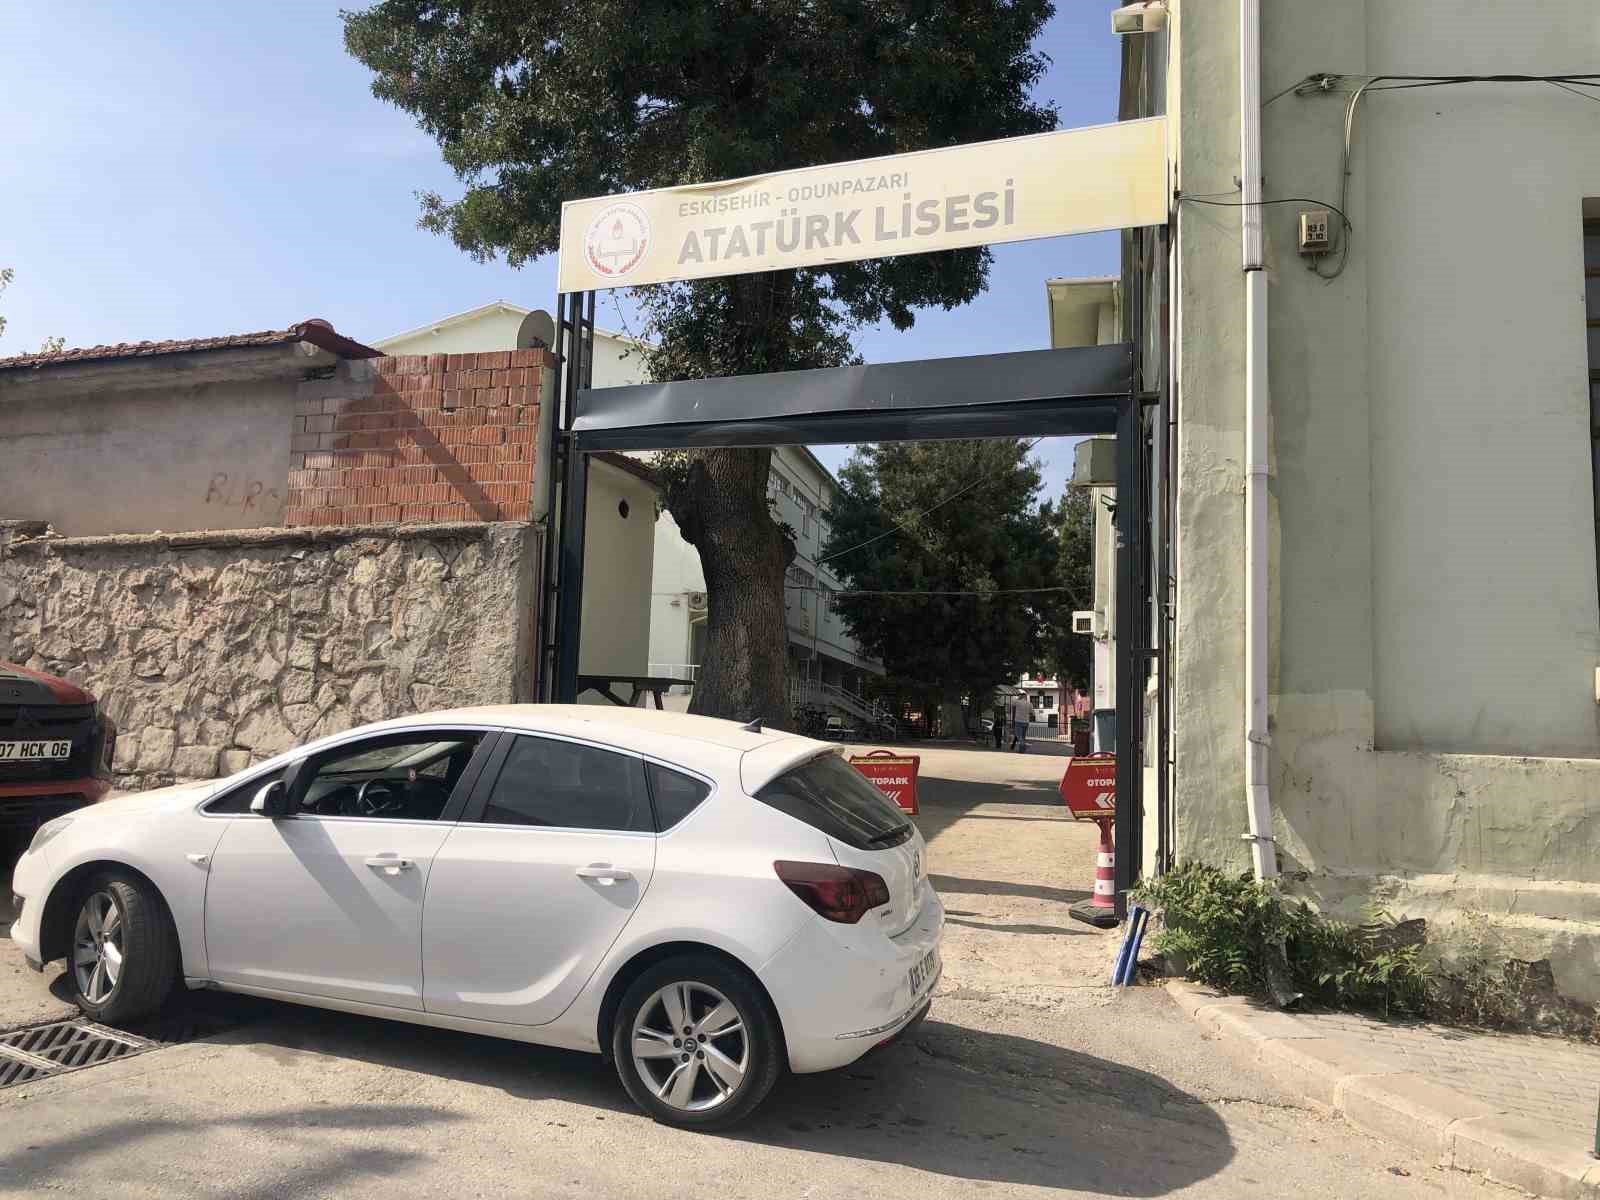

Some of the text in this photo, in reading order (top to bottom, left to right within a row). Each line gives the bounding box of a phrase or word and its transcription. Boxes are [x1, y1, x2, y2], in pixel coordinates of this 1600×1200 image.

[788, 172, 908, 202] ODUNPAZARI
[677, 207, 863, 265] ATATÜRK
[874, 178, 1015, 241] LİSESİ
[20, 743, 46, 757] HCK
[52, 742, 69, 757] 06
